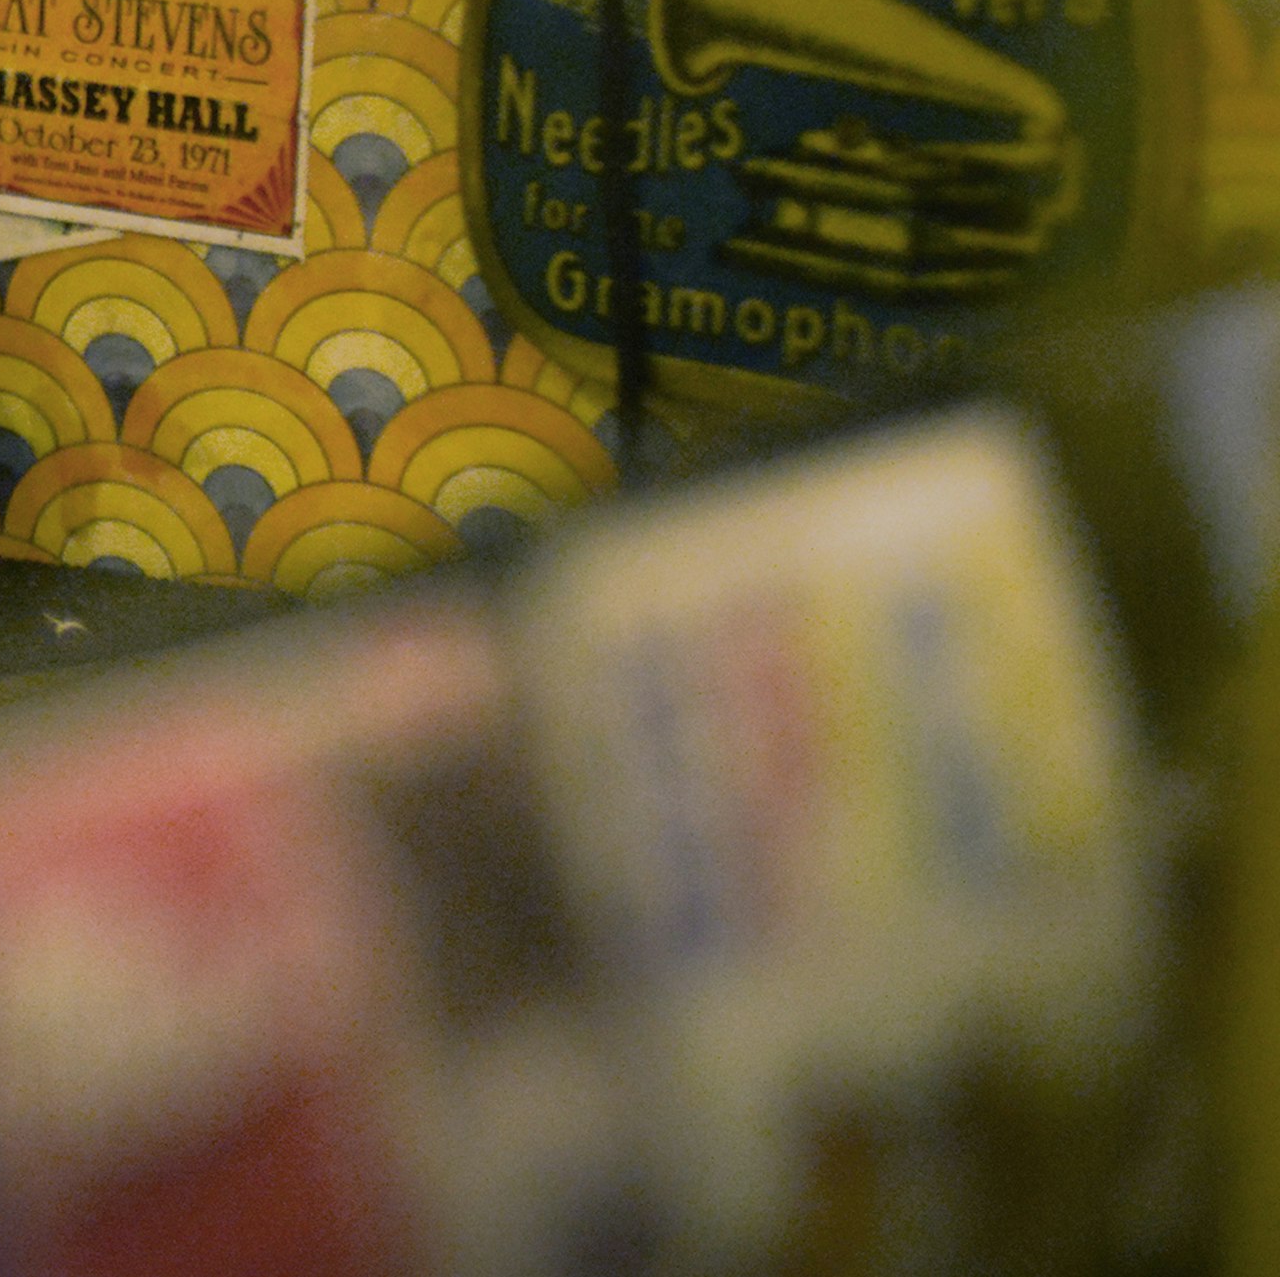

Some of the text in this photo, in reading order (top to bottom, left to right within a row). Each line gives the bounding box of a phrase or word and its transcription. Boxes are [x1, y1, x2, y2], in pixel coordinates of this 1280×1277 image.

[10, 42, 222, 83] IN CONCERT
[146, 89, 260, 143] HALL
[179, 140, 232, 177] 1971
